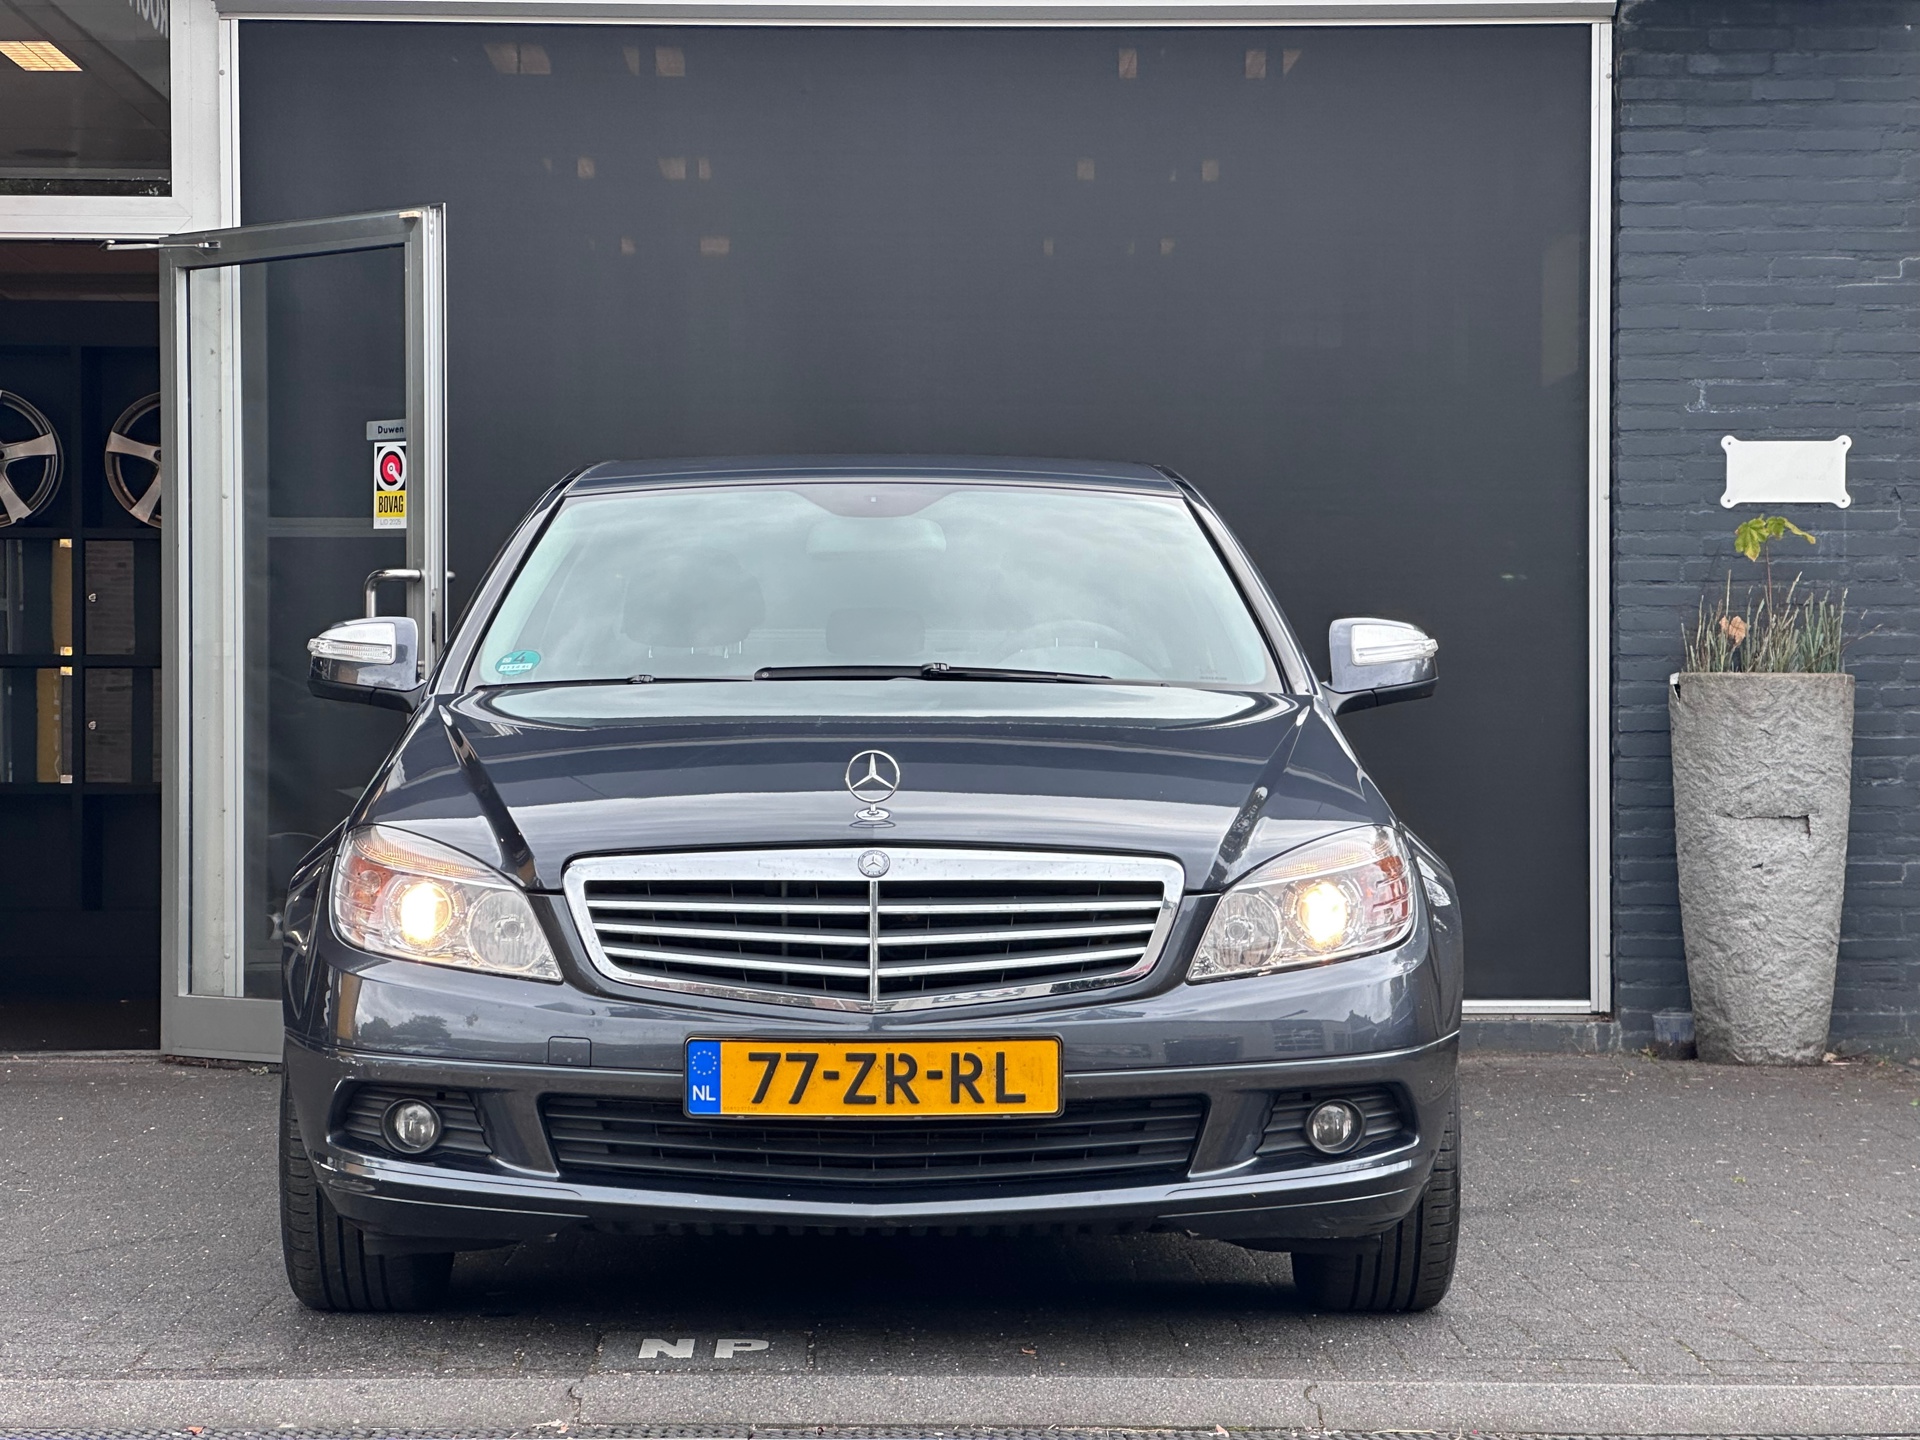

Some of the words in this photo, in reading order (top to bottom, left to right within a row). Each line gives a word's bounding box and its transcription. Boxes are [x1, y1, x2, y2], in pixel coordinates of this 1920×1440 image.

[378, 425, 404, 435] Duwen
[378, 495, 404, 513] BOVAG
[748, 1051, 1027, 1105] 77-ZR-RL
[692, 1085, 716, 1102] NL
